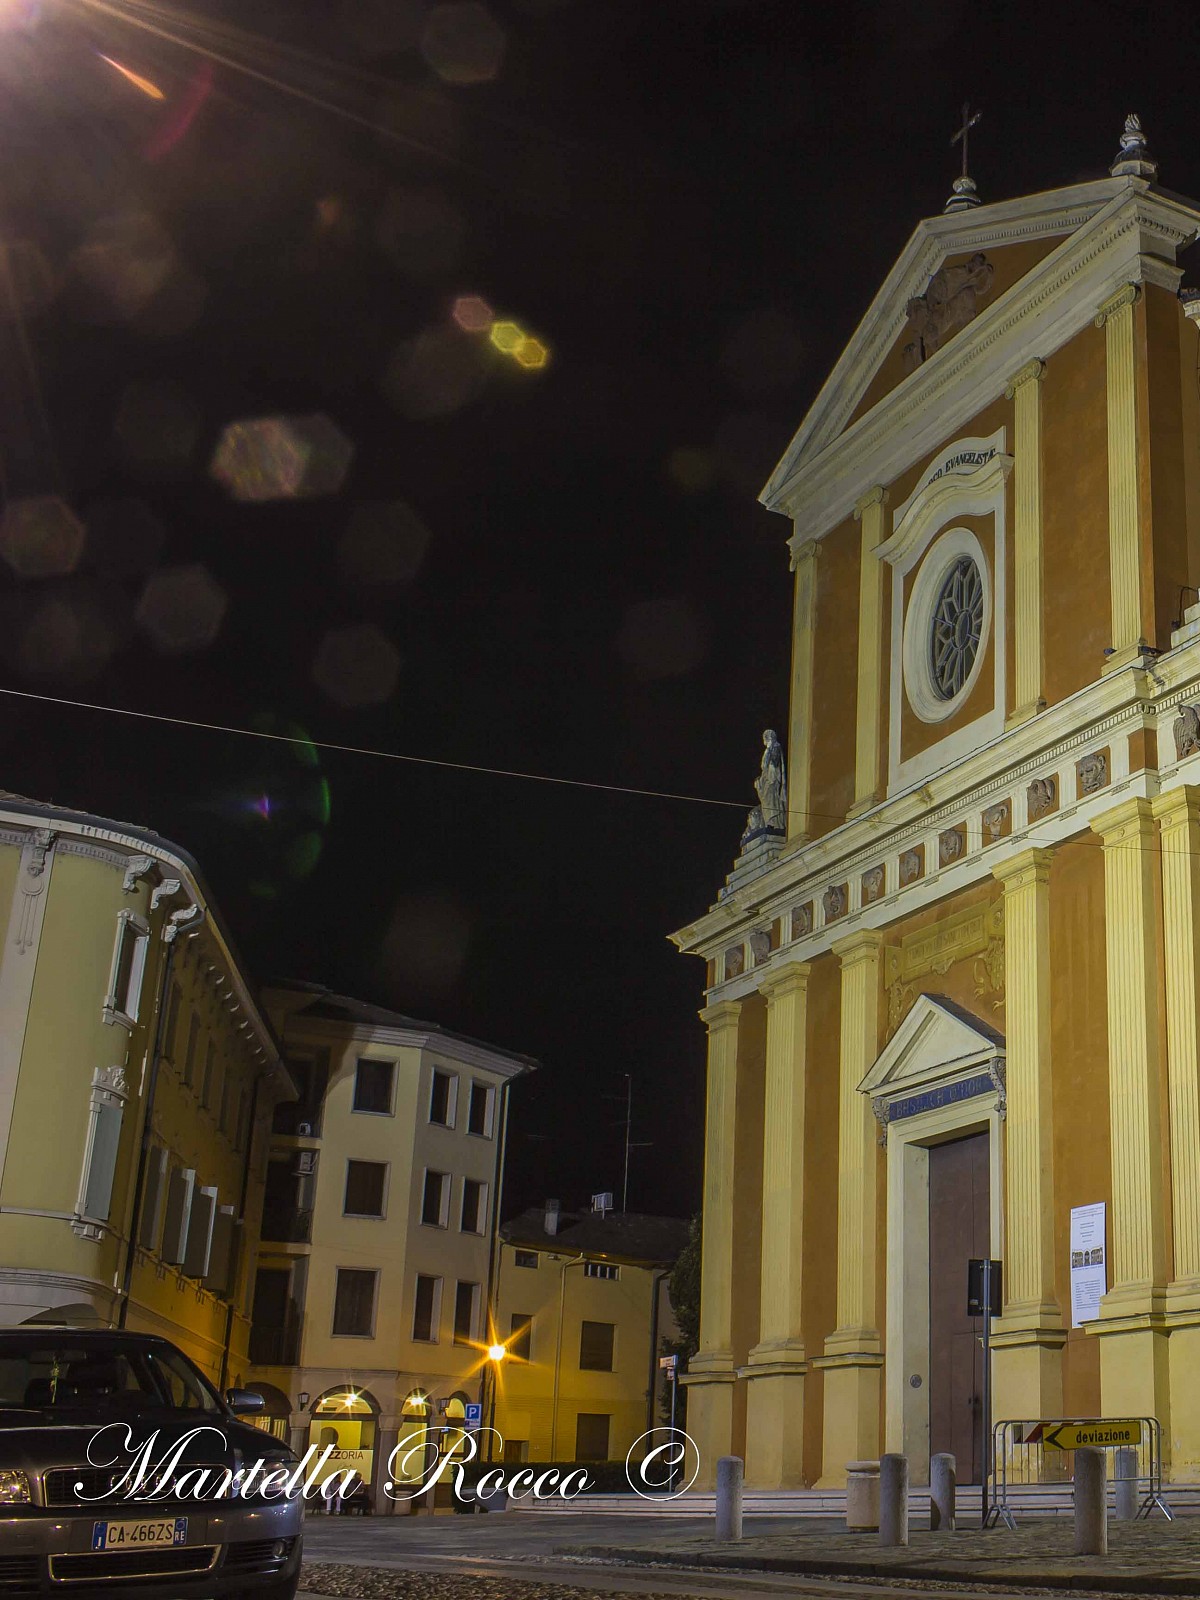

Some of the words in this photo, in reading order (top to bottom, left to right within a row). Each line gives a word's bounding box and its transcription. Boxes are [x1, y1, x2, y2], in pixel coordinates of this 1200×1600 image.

[468, 1407, 477, 1418] P
[1076, 1428, 1130, 1444] deviazione
[317, 1450, 363, 1460] PZZORIA
[174, 1530, 185, 1542] RE
